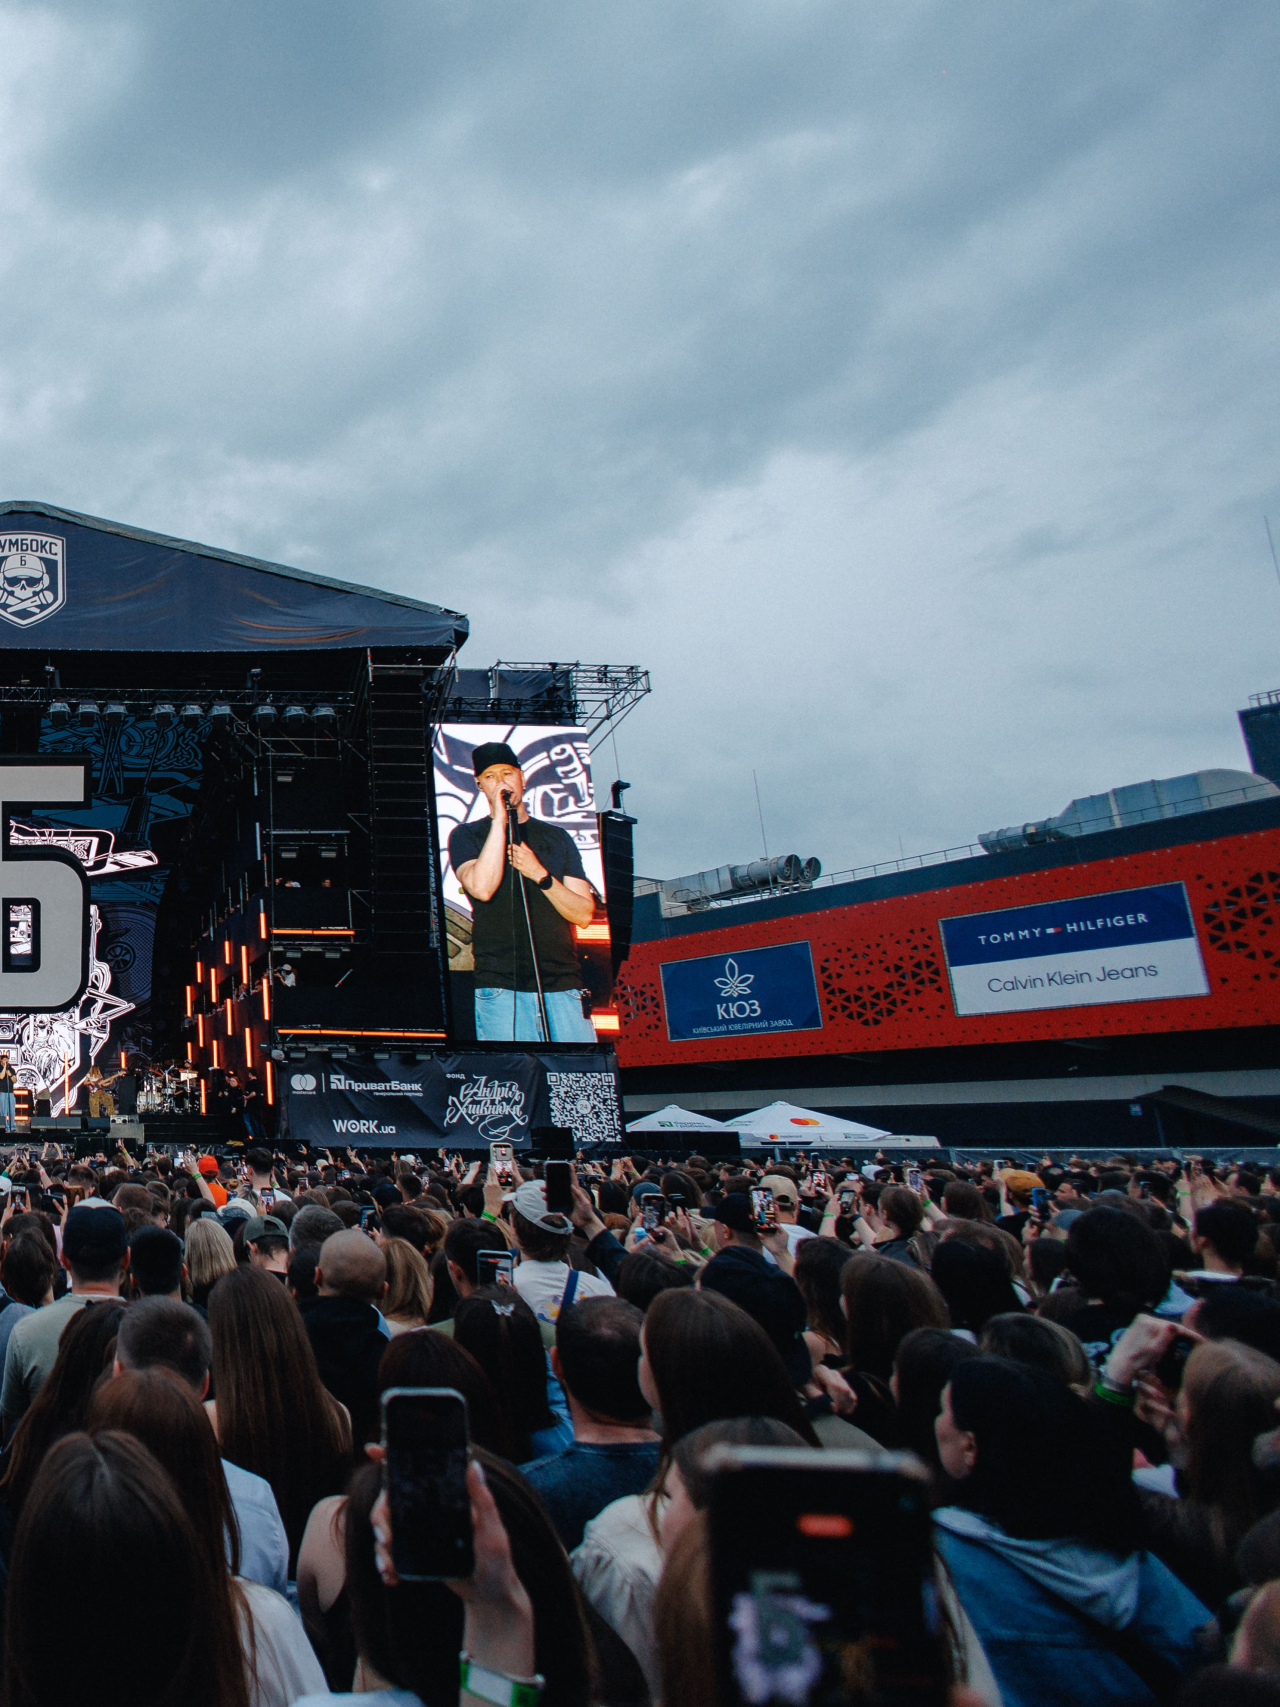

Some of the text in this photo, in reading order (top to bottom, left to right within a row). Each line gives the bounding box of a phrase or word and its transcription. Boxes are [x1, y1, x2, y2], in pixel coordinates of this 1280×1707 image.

[977, 913, 1149, 945] TOMMY HILFIGER
[987, 964, 1159, 993] Calvin Klein Jeans
[716, 1000, 761, 1020] КЮЗ
[770, 1019, 793, 1028] ЗАВОД
[345, 1080, 423, 1092] ПриватБанк
[332, 1119, 396, 1134] WORK.ua
